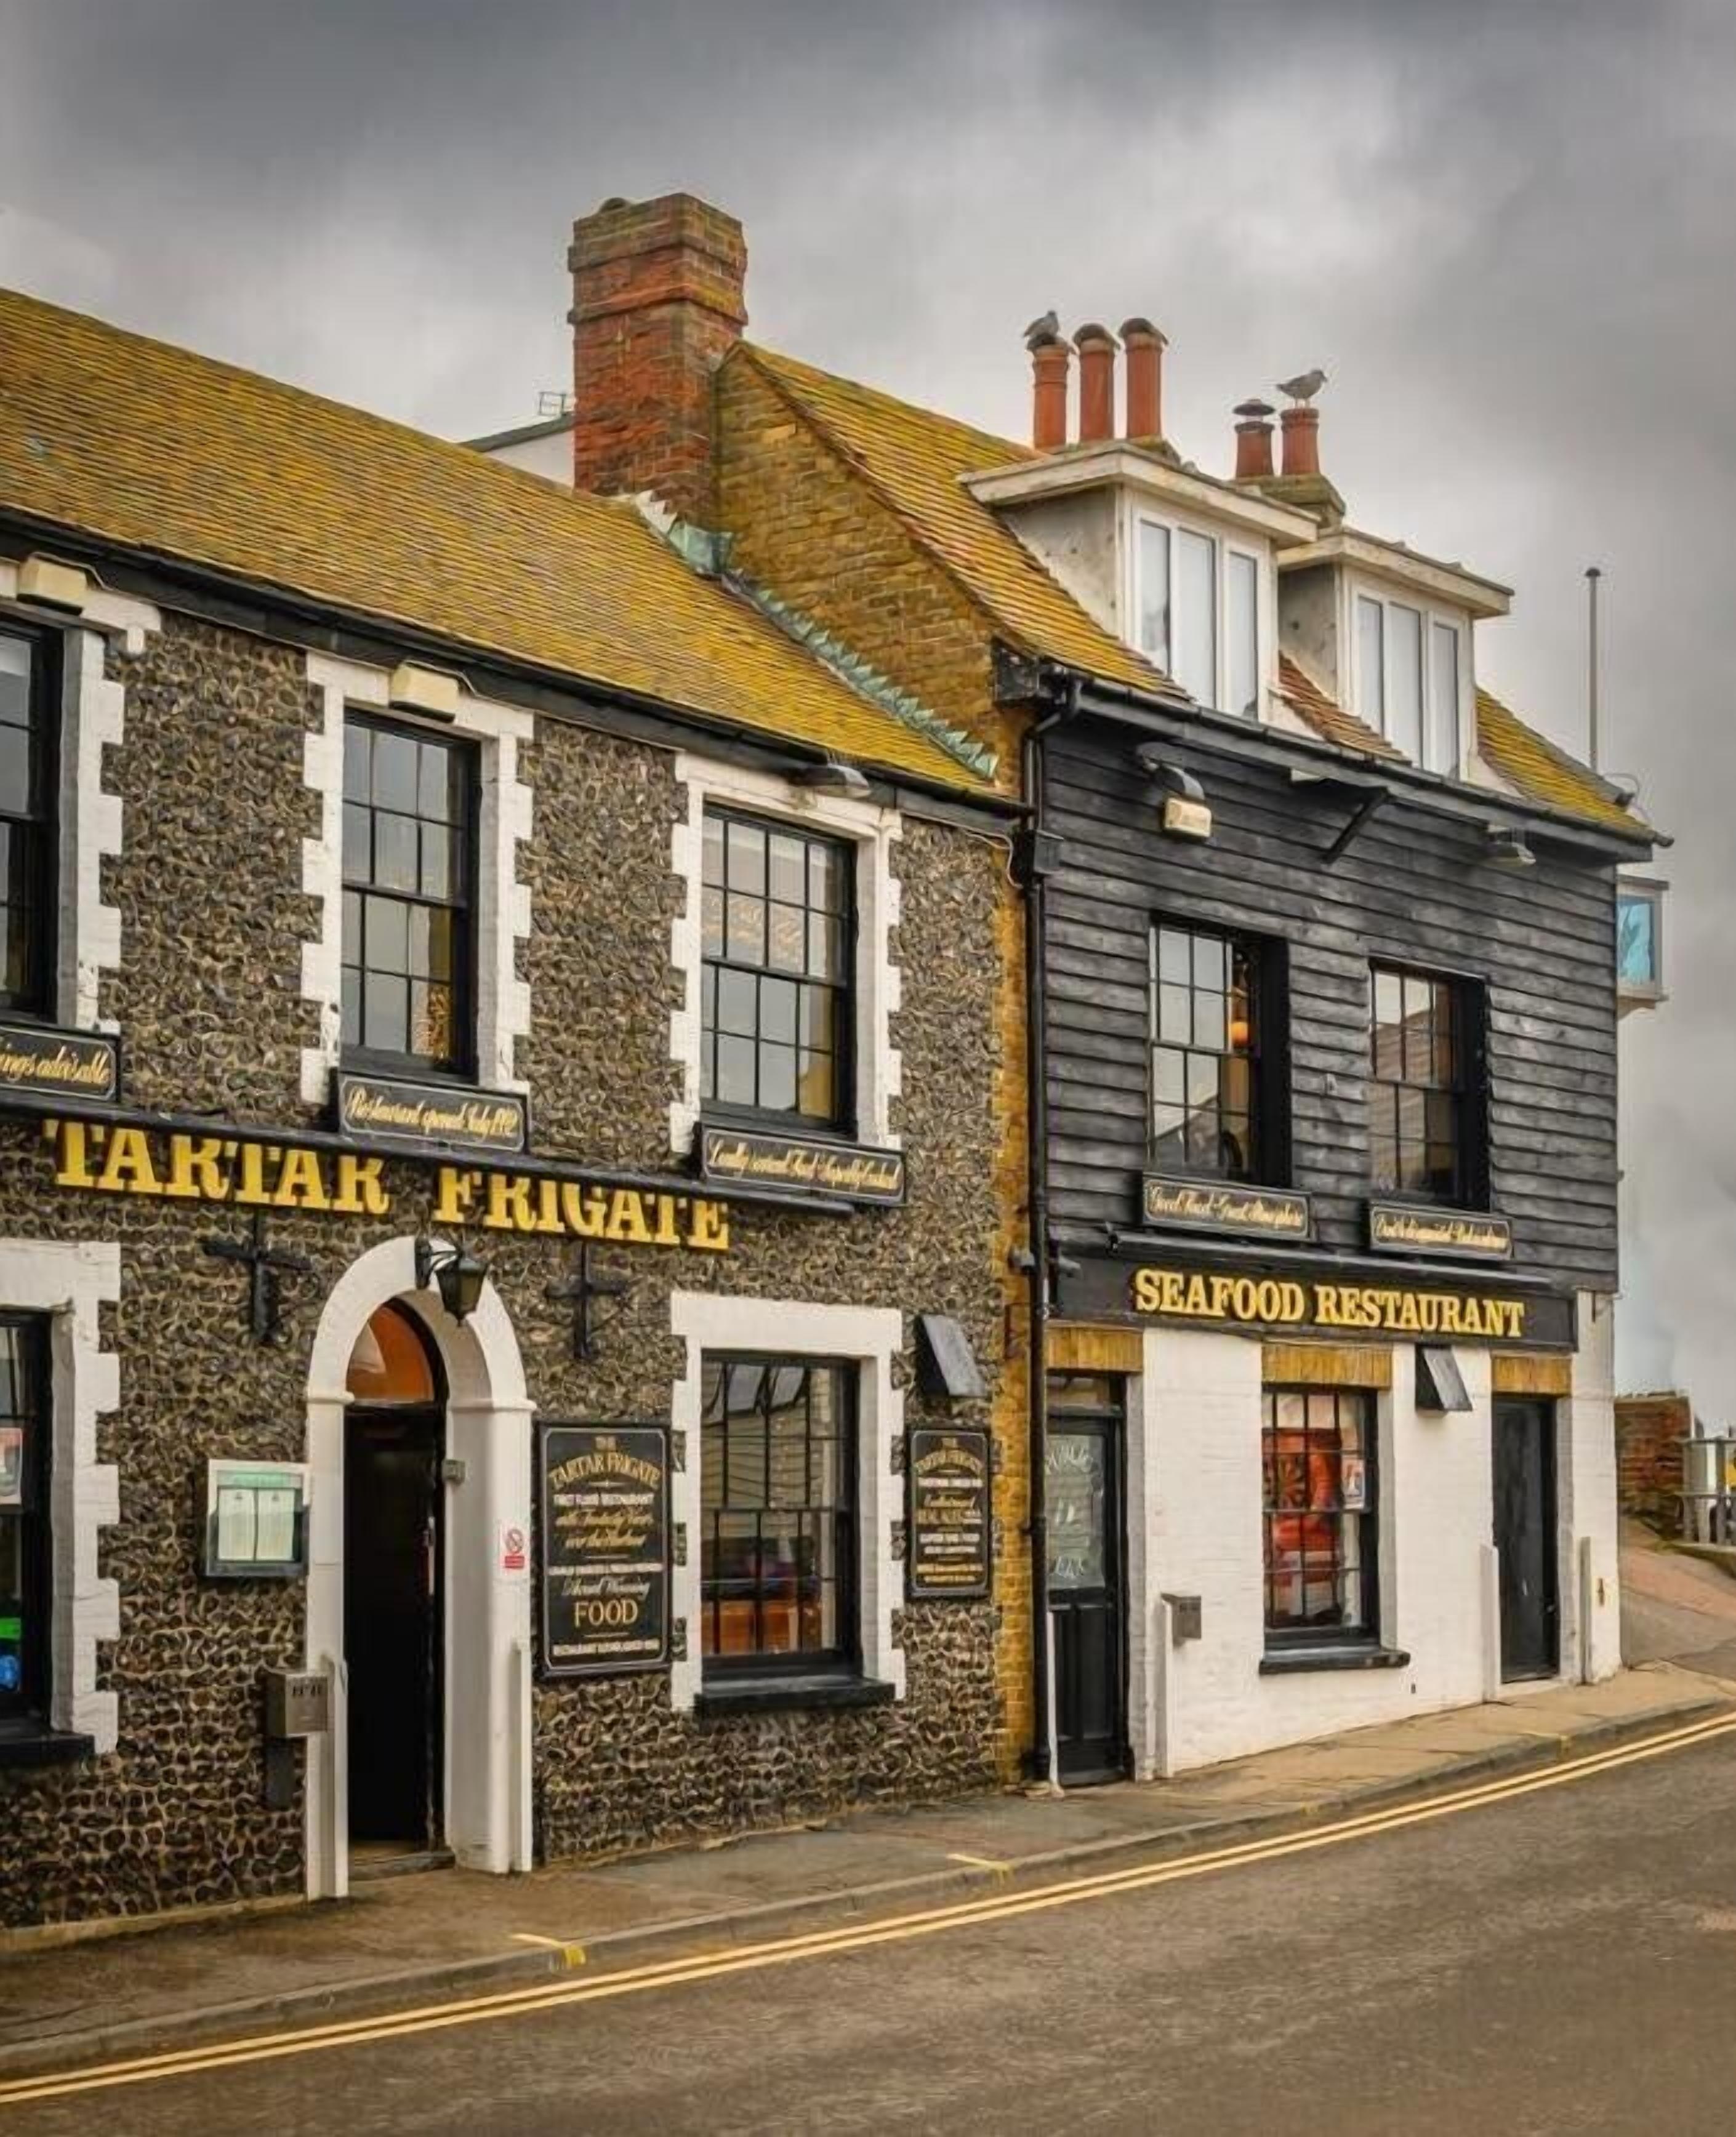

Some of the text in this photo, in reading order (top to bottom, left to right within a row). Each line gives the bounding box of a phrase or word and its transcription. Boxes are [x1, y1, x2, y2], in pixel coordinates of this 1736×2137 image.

[43, 1119, 390, 1214] TARTAR
[431, 1167, 730, 1250] FRIGATE
[1135, 1268, 1524, 1337] SEAFOOD RESTAURANT
[574, 1598, 638, 1628] FOOD
